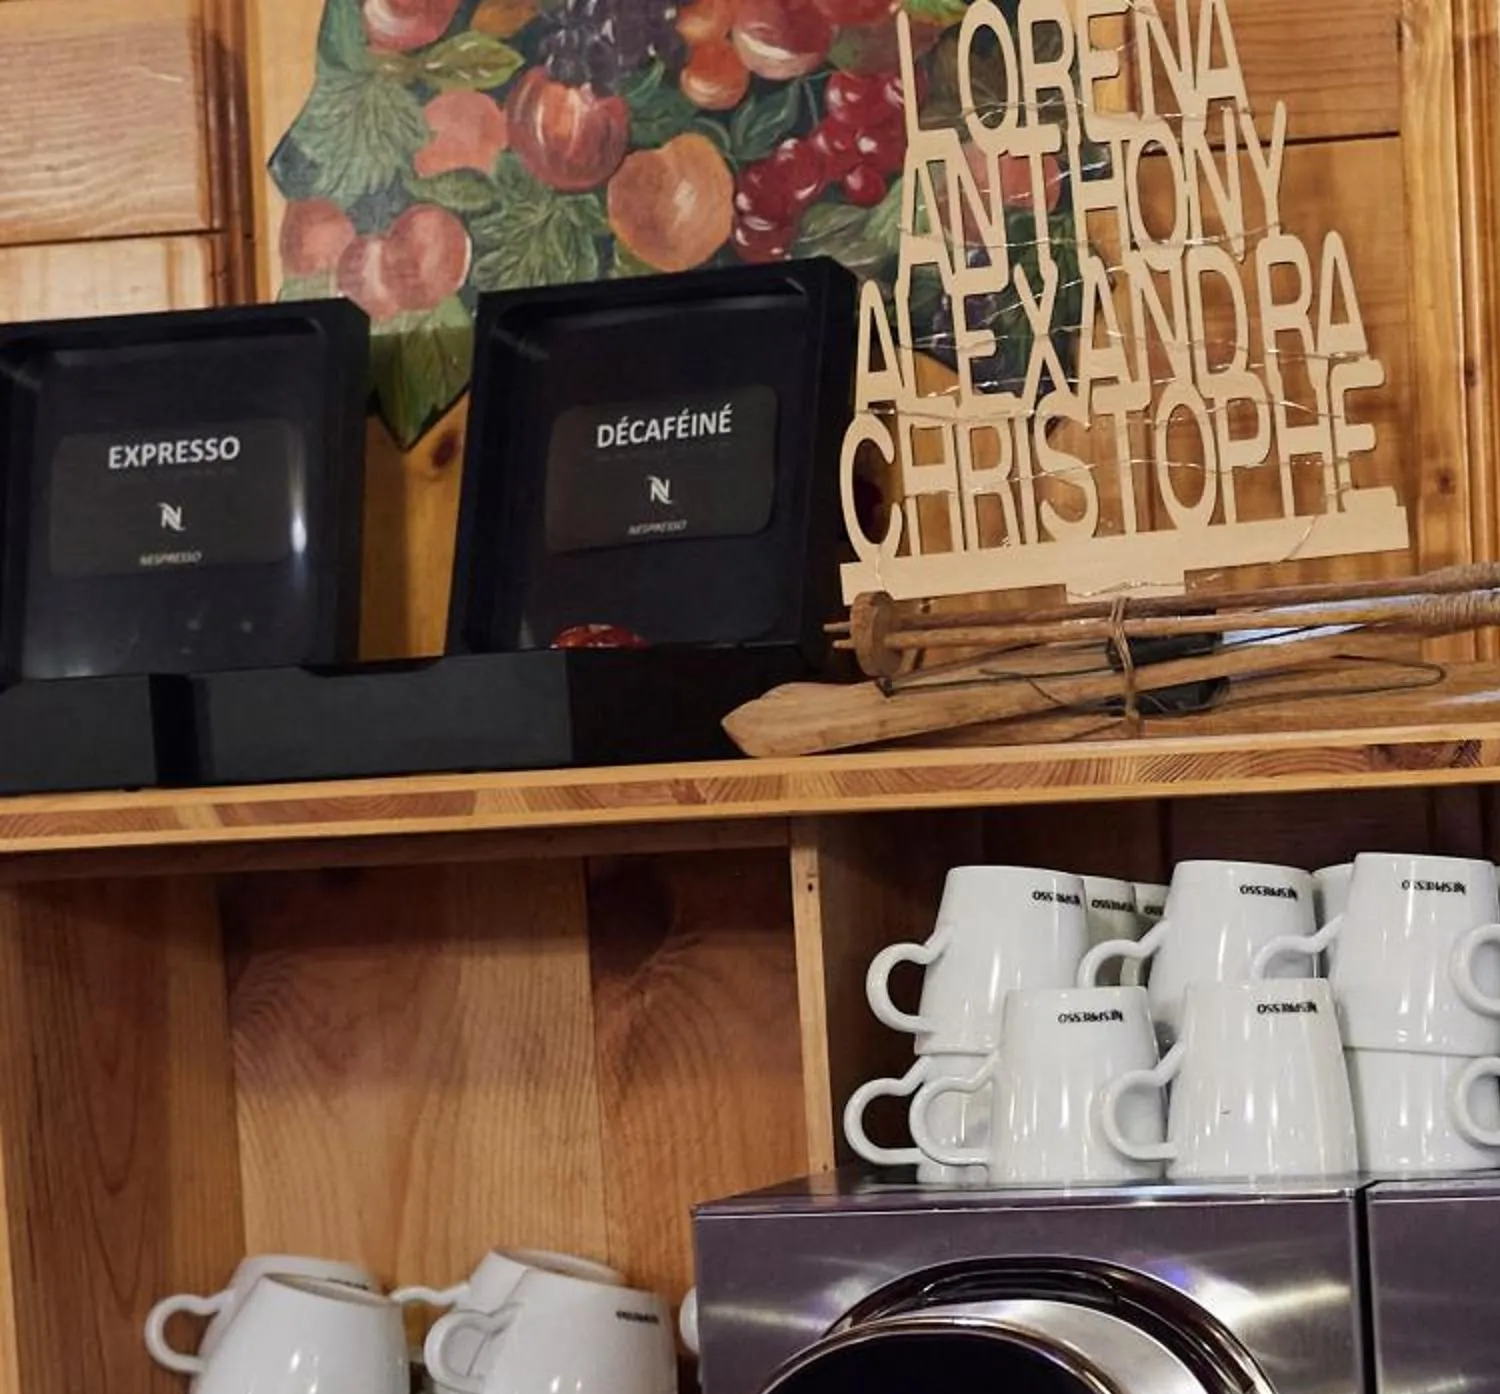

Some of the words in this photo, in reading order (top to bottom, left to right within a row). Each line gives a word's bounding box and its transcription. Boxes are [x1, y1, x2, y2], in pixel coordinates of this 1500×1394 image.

[896, 0, 1252, 150] LORENA
[897, 100, 1287, 290] ANTHONY
[855, 231, 1370, 412] ALEXANDRA
[597, 403, 733, 448] DÉCAFÉINÉ
[108, 435, 241, 470] EXPRESSO
[840, 360, 1398, 560] CHRISTOPHE
[1239, 884, 1298, 901] NESPRESSO
[1057, 1009, 1124, 1024] NESPRESSO
[1256, 1001, 1319, 1014] NESPRESSO
